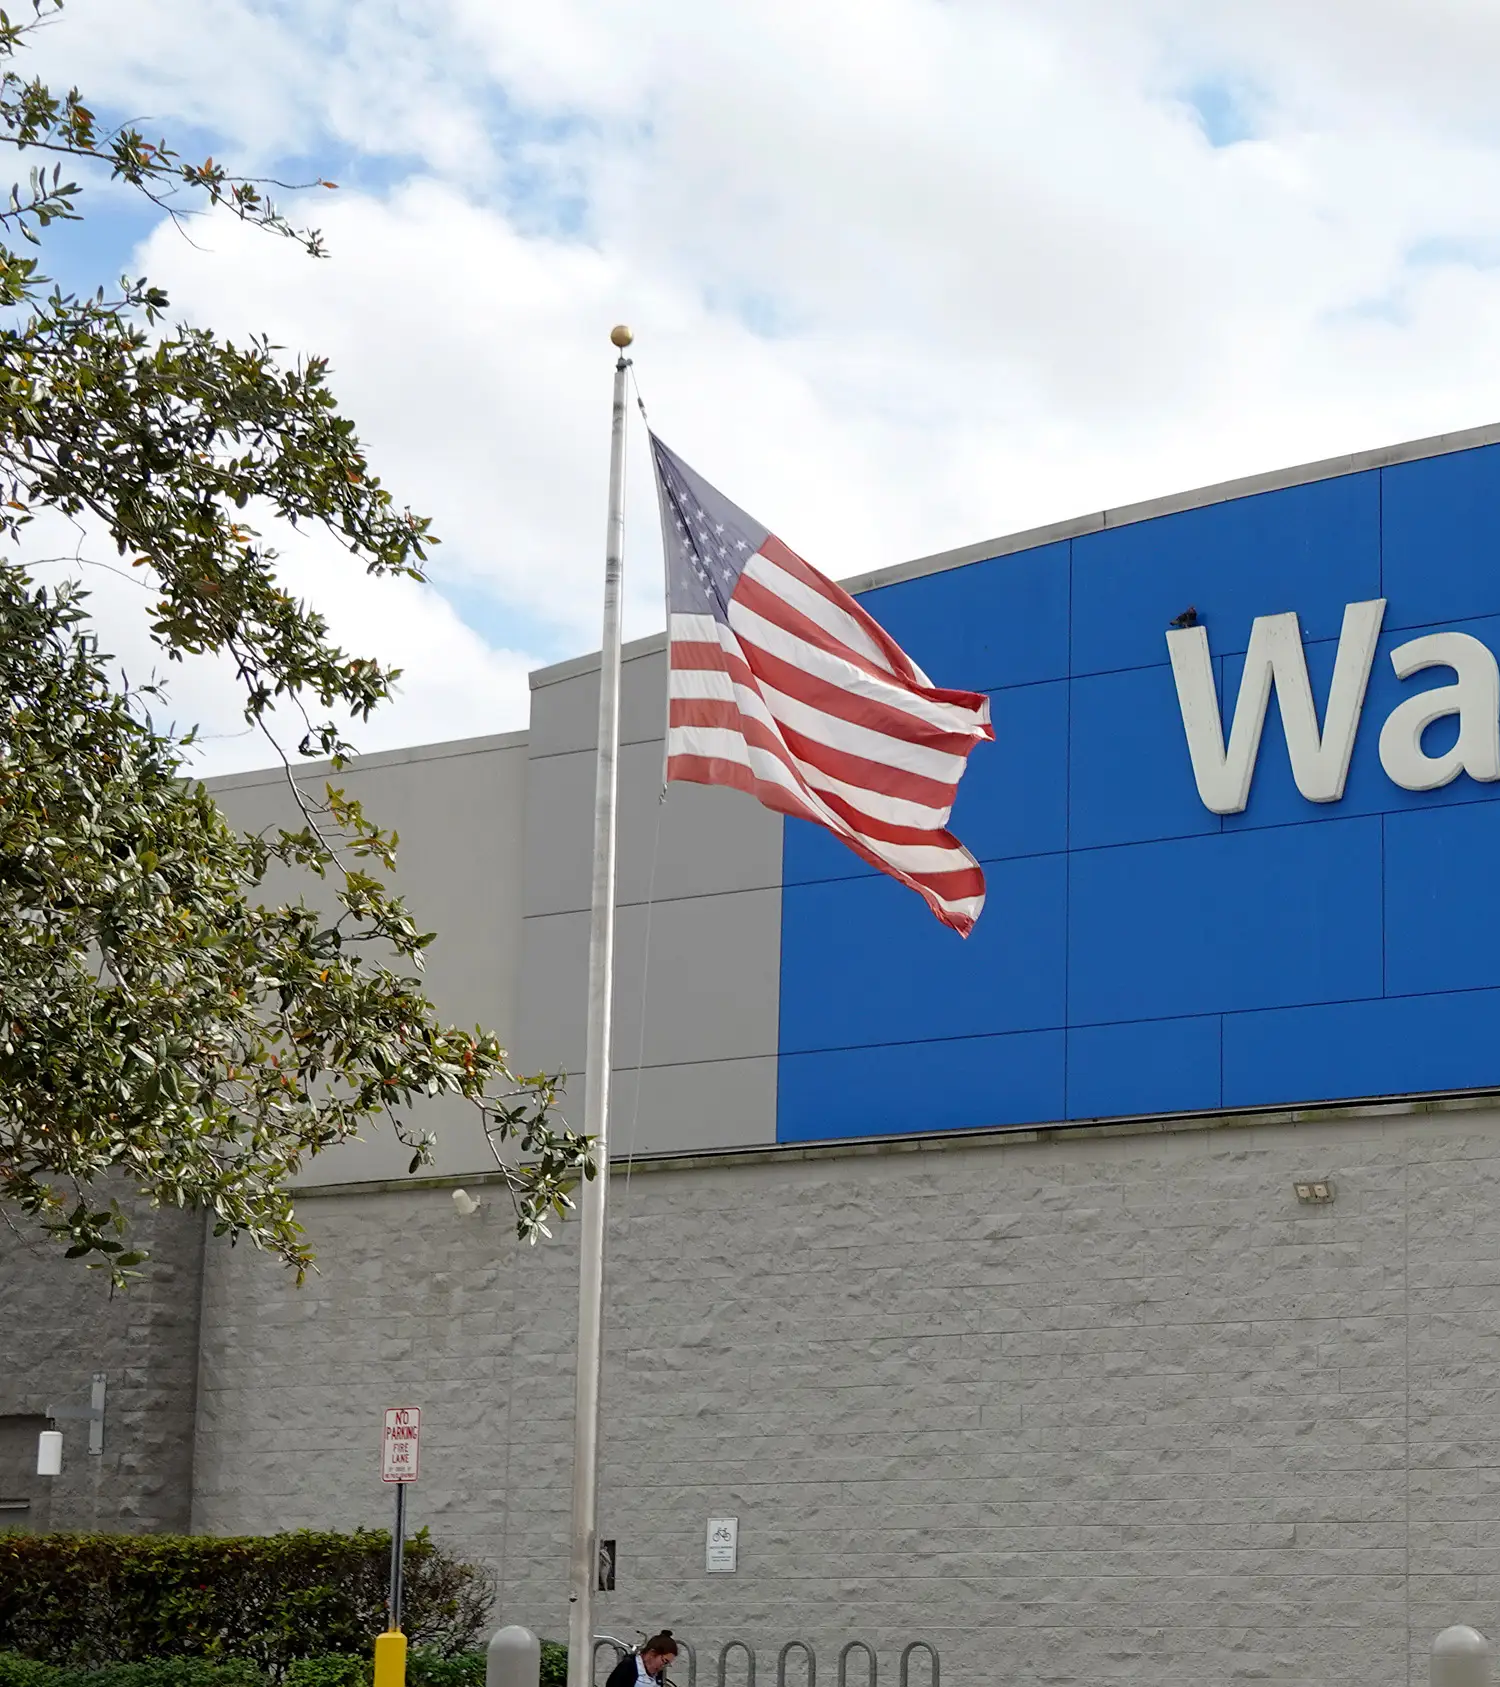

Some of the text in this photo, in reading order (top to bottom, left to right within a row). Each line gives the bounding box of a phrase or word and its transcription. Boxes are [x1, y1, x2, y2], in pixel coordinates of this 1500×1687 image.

[395, 1411, 409, 1425] NO
[386, 1426, 418, 1440] PARKING
[393, 1443, 409, 1453] FIRE
[392, 1454, 409, 1464] LANE
